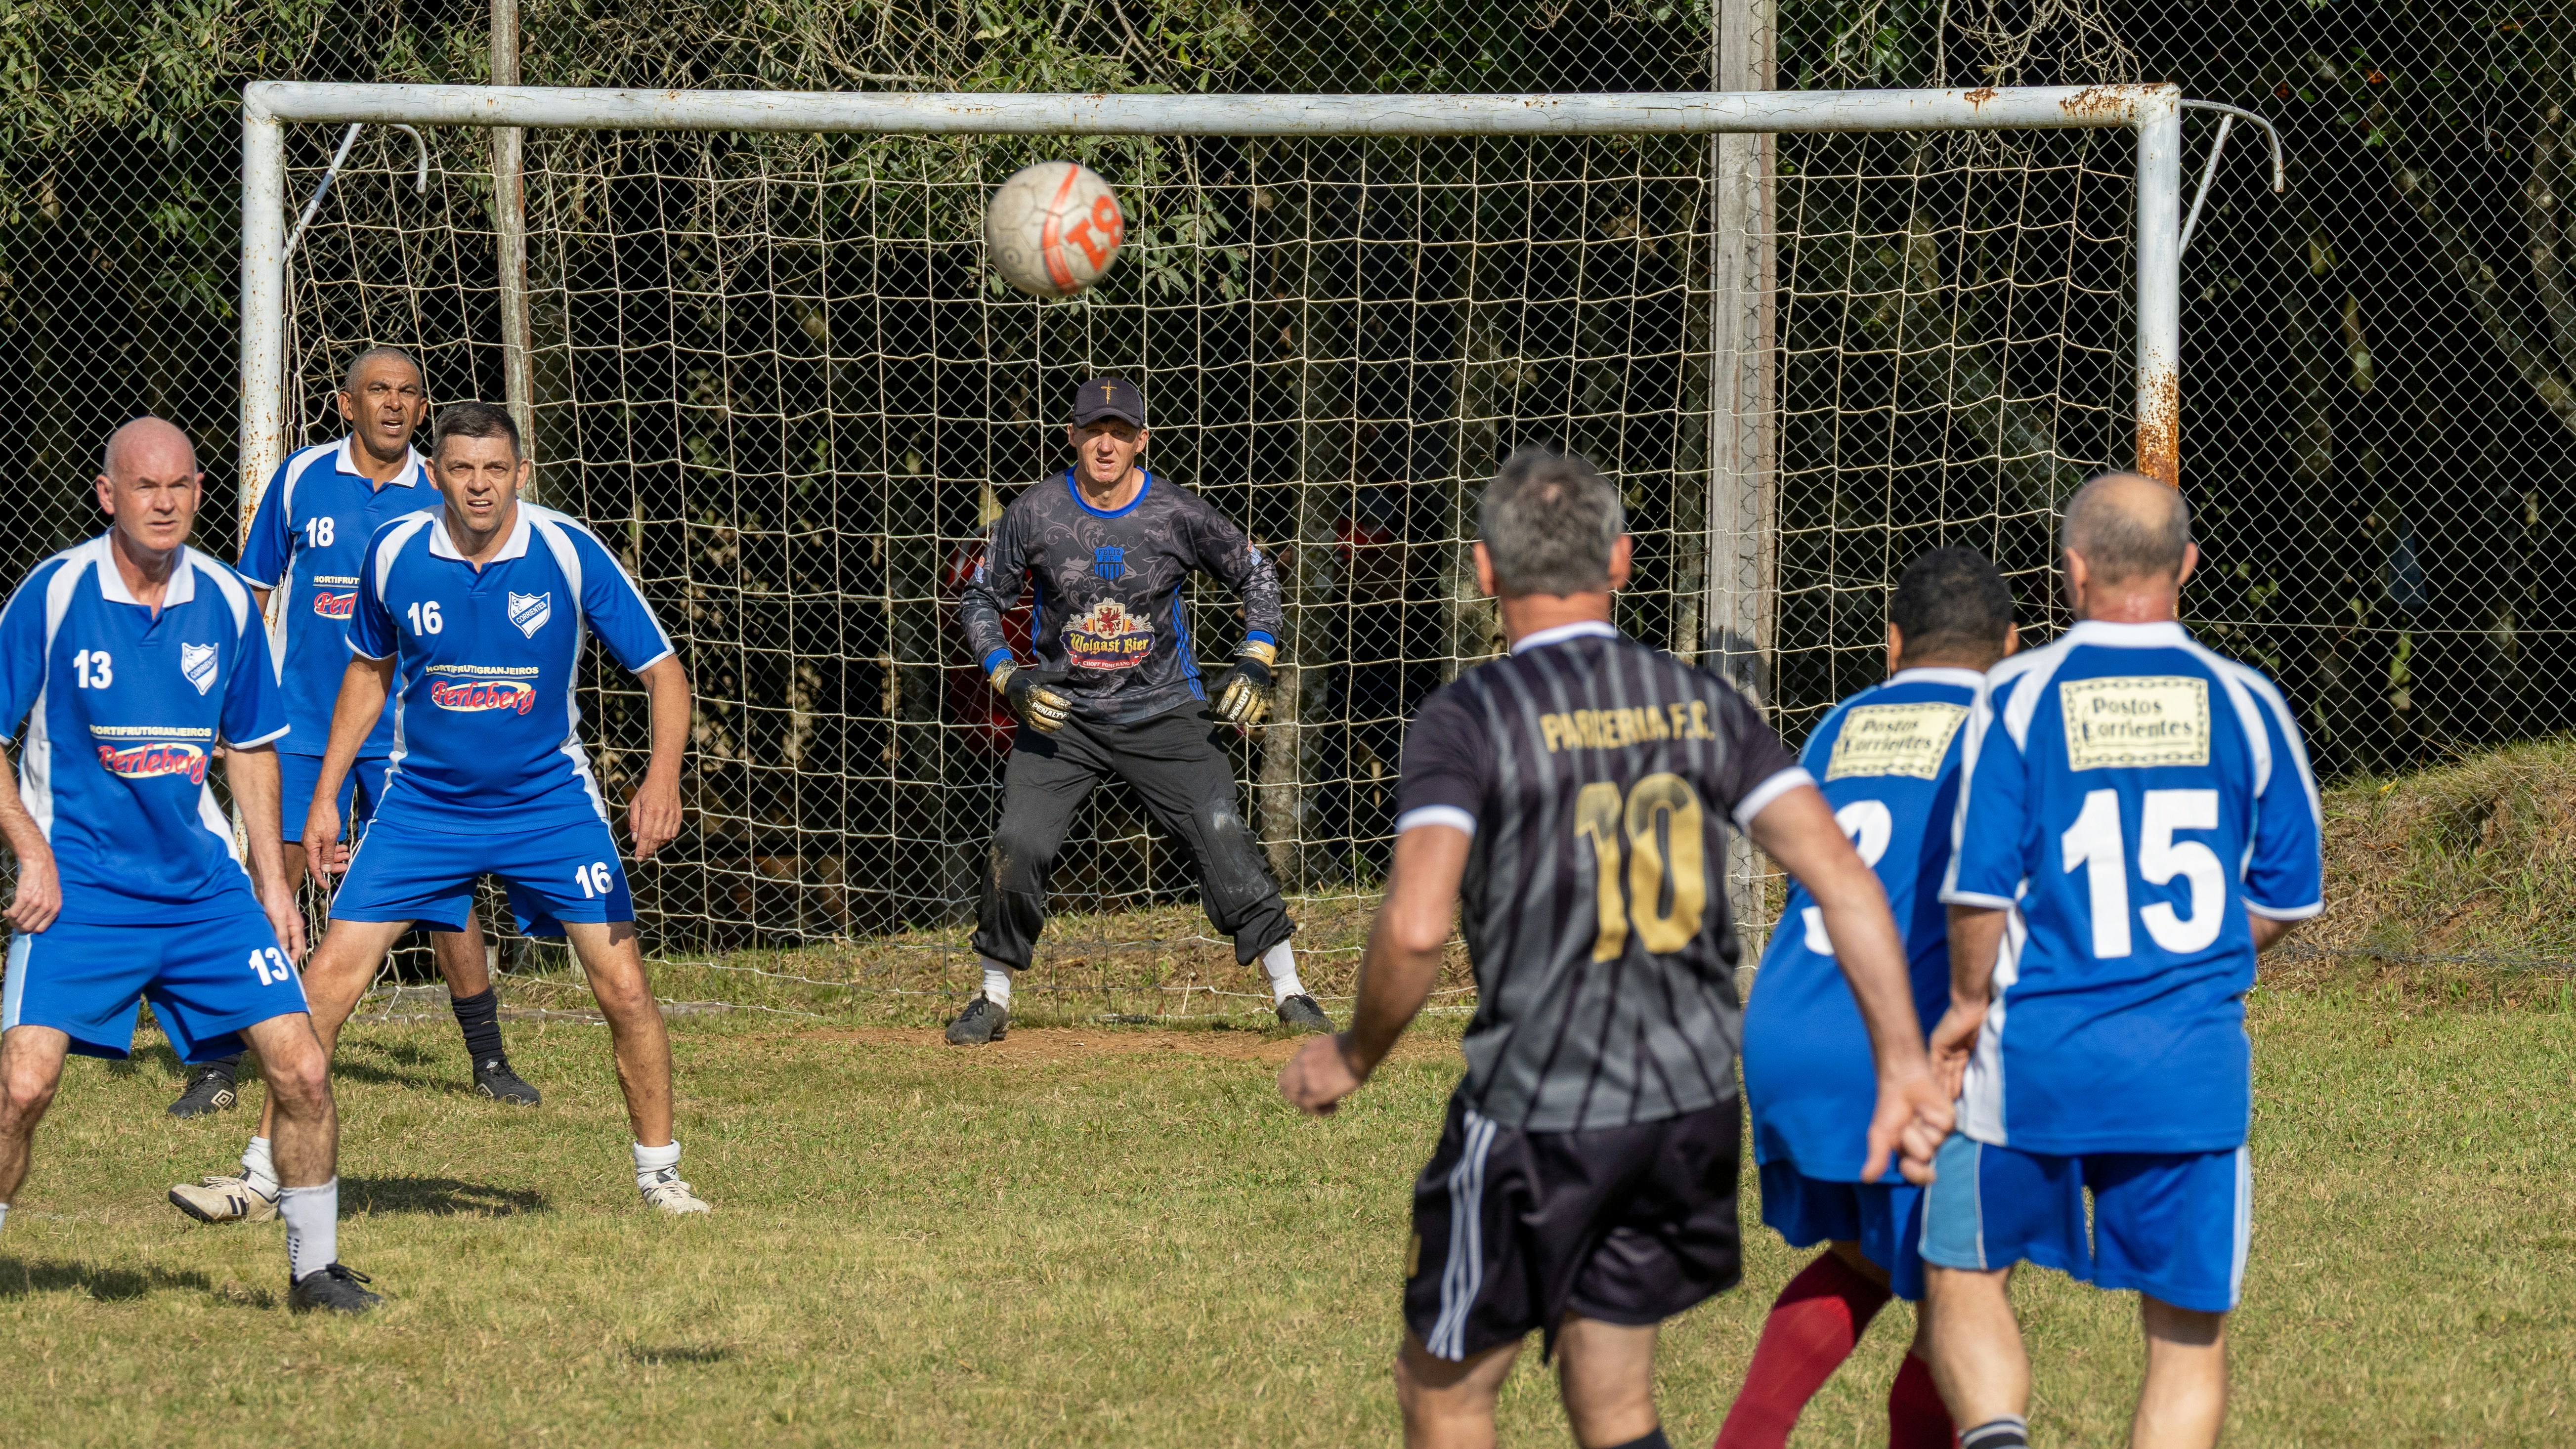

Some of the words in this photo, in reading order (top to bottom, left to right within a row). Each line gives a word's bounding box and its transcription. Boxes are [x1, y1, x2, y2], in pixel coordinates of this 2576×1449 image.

[306, 516, 334, 548] 18
[407, 600, 443, 636] 16
[516, 601, 547, 624] CORRIENTES
[1070, 633, 1120, 655] Wolgast
[1121, 637, 1149, 653] Bier
[73, 649, 113, 689] 13
[425, 665, 539, 675] HORTIFRUTIGRANJEIROS
[431, 681, 536, 715] Perleberg
[1031, 701, 1068, 720] PENALTY
[2092, 696, 2163, 714] Postos
[89, 724, 212, 737] HORTIFRUTIGRANJEIROS
[97, 743, 208, 784] Perleberg
[575, 861, 613, 898] 16
[1574, 772, 1706, 964] 10
[2061, 788, 2226, 959] 15
[249, 947, 289, 986] 13
